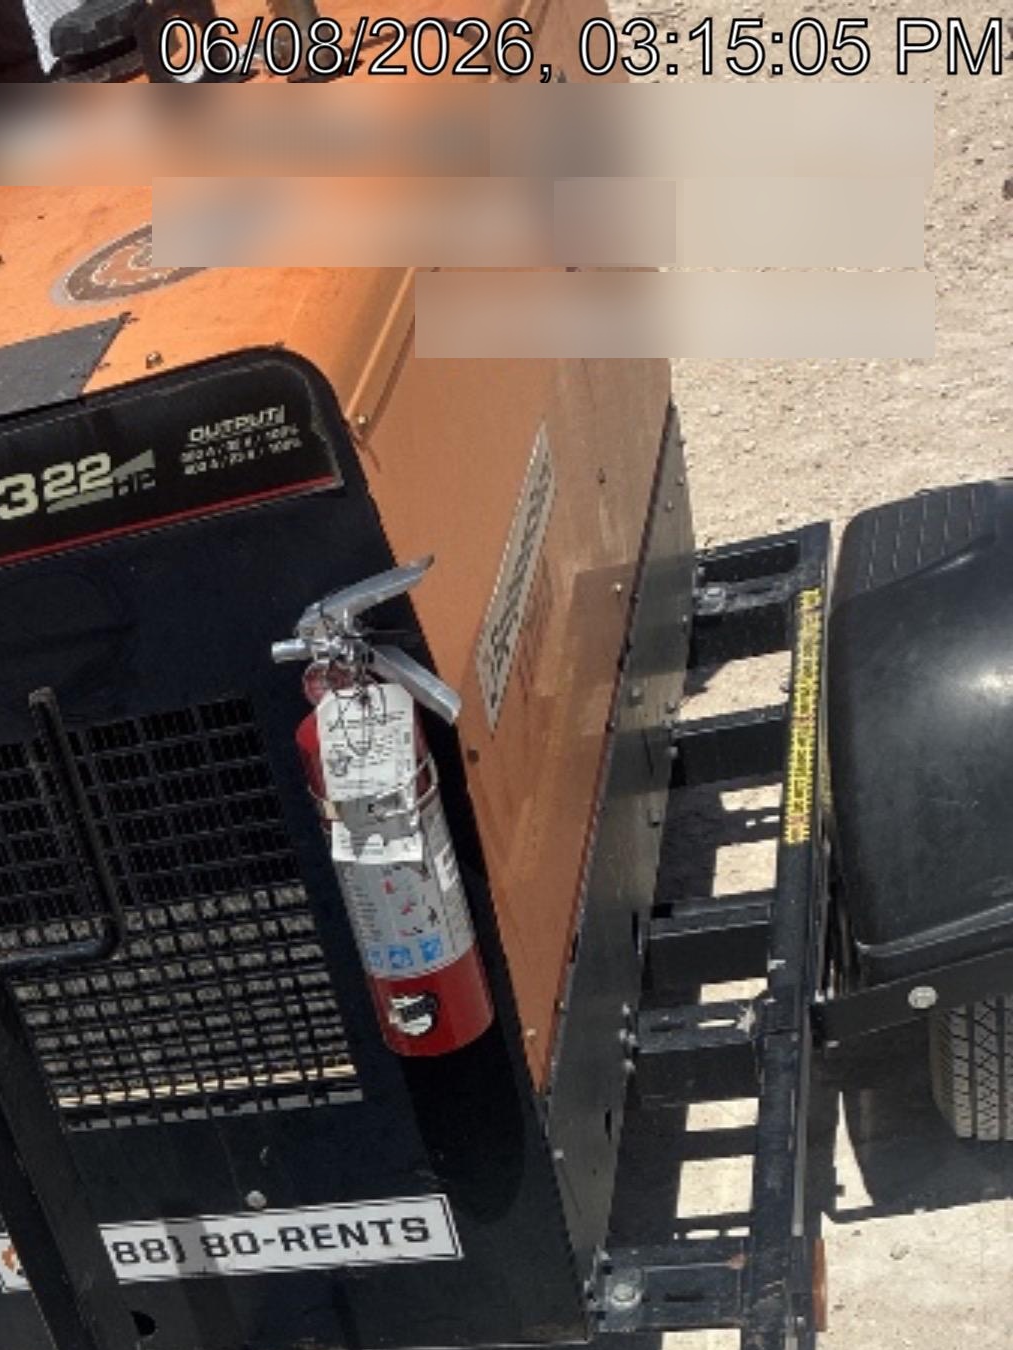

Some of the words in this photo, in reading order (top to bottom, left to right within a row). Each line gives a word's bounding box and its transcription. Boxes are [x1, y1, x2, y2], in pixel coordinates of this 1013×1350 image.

[189, 406, 278, 442] OUTPUT
[112, 1235, 187, 1264] 88)
[200, 1216, 430, 1258] 80-RENTS
